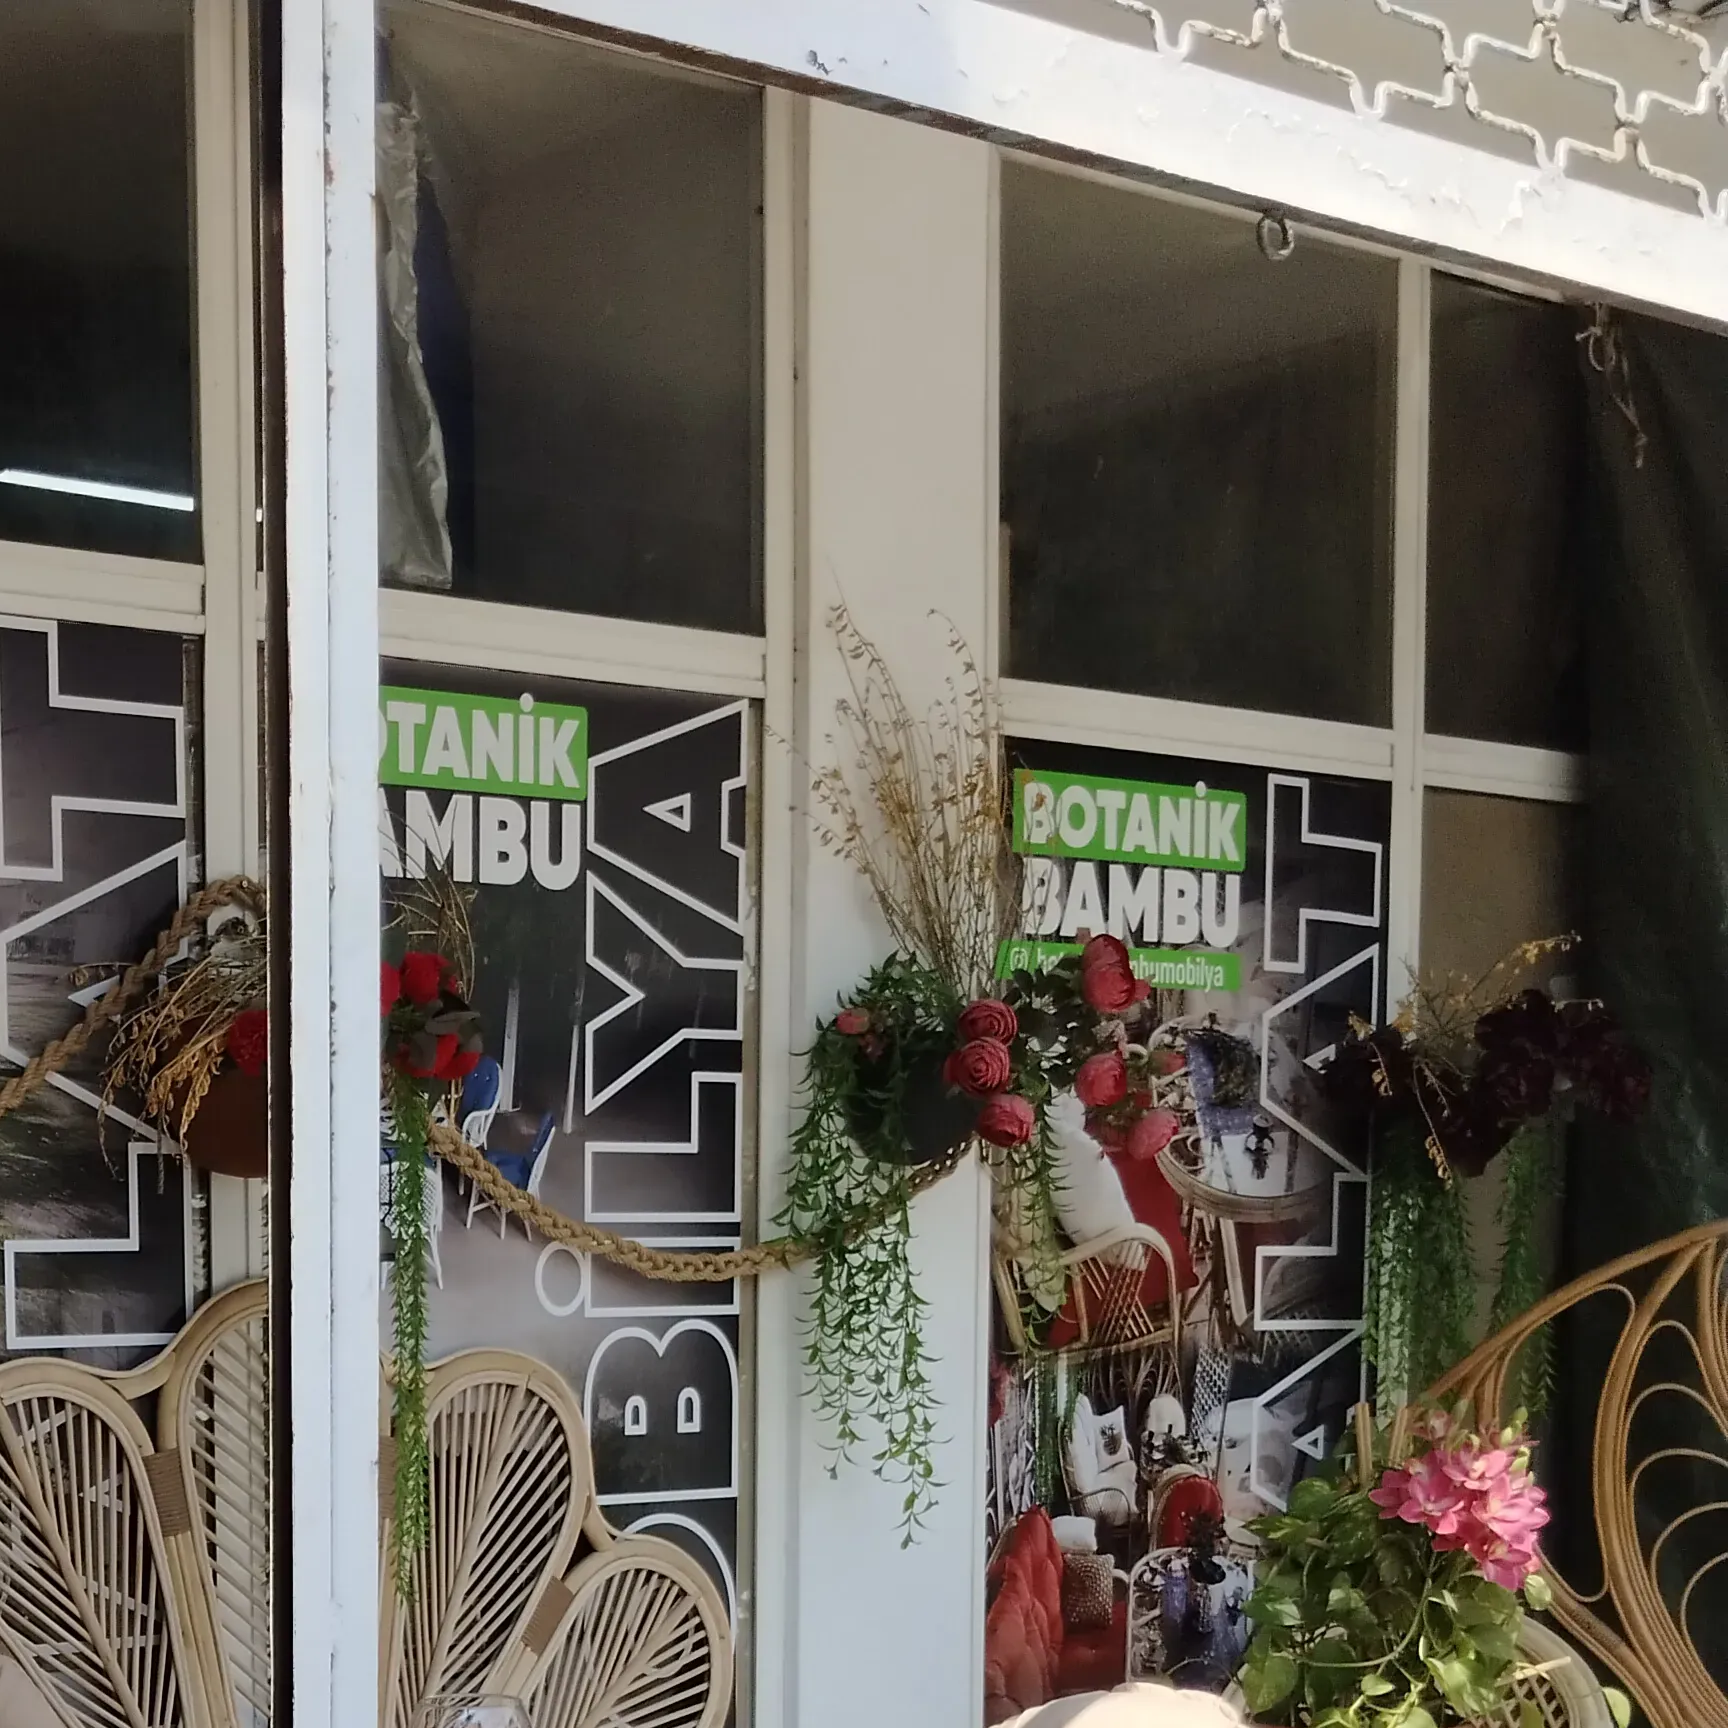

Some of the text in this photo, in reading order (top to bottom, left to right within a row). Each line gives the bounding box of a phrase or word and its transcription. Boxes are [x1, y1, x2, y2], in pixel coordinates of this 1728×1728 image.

[379, 692, 581, 789] TANİK
[379, 787, 582, 891] MBU
[1023, 780, 1241, 863] BOTANİK
[1023, 857, 1241, 949] BAMBU
